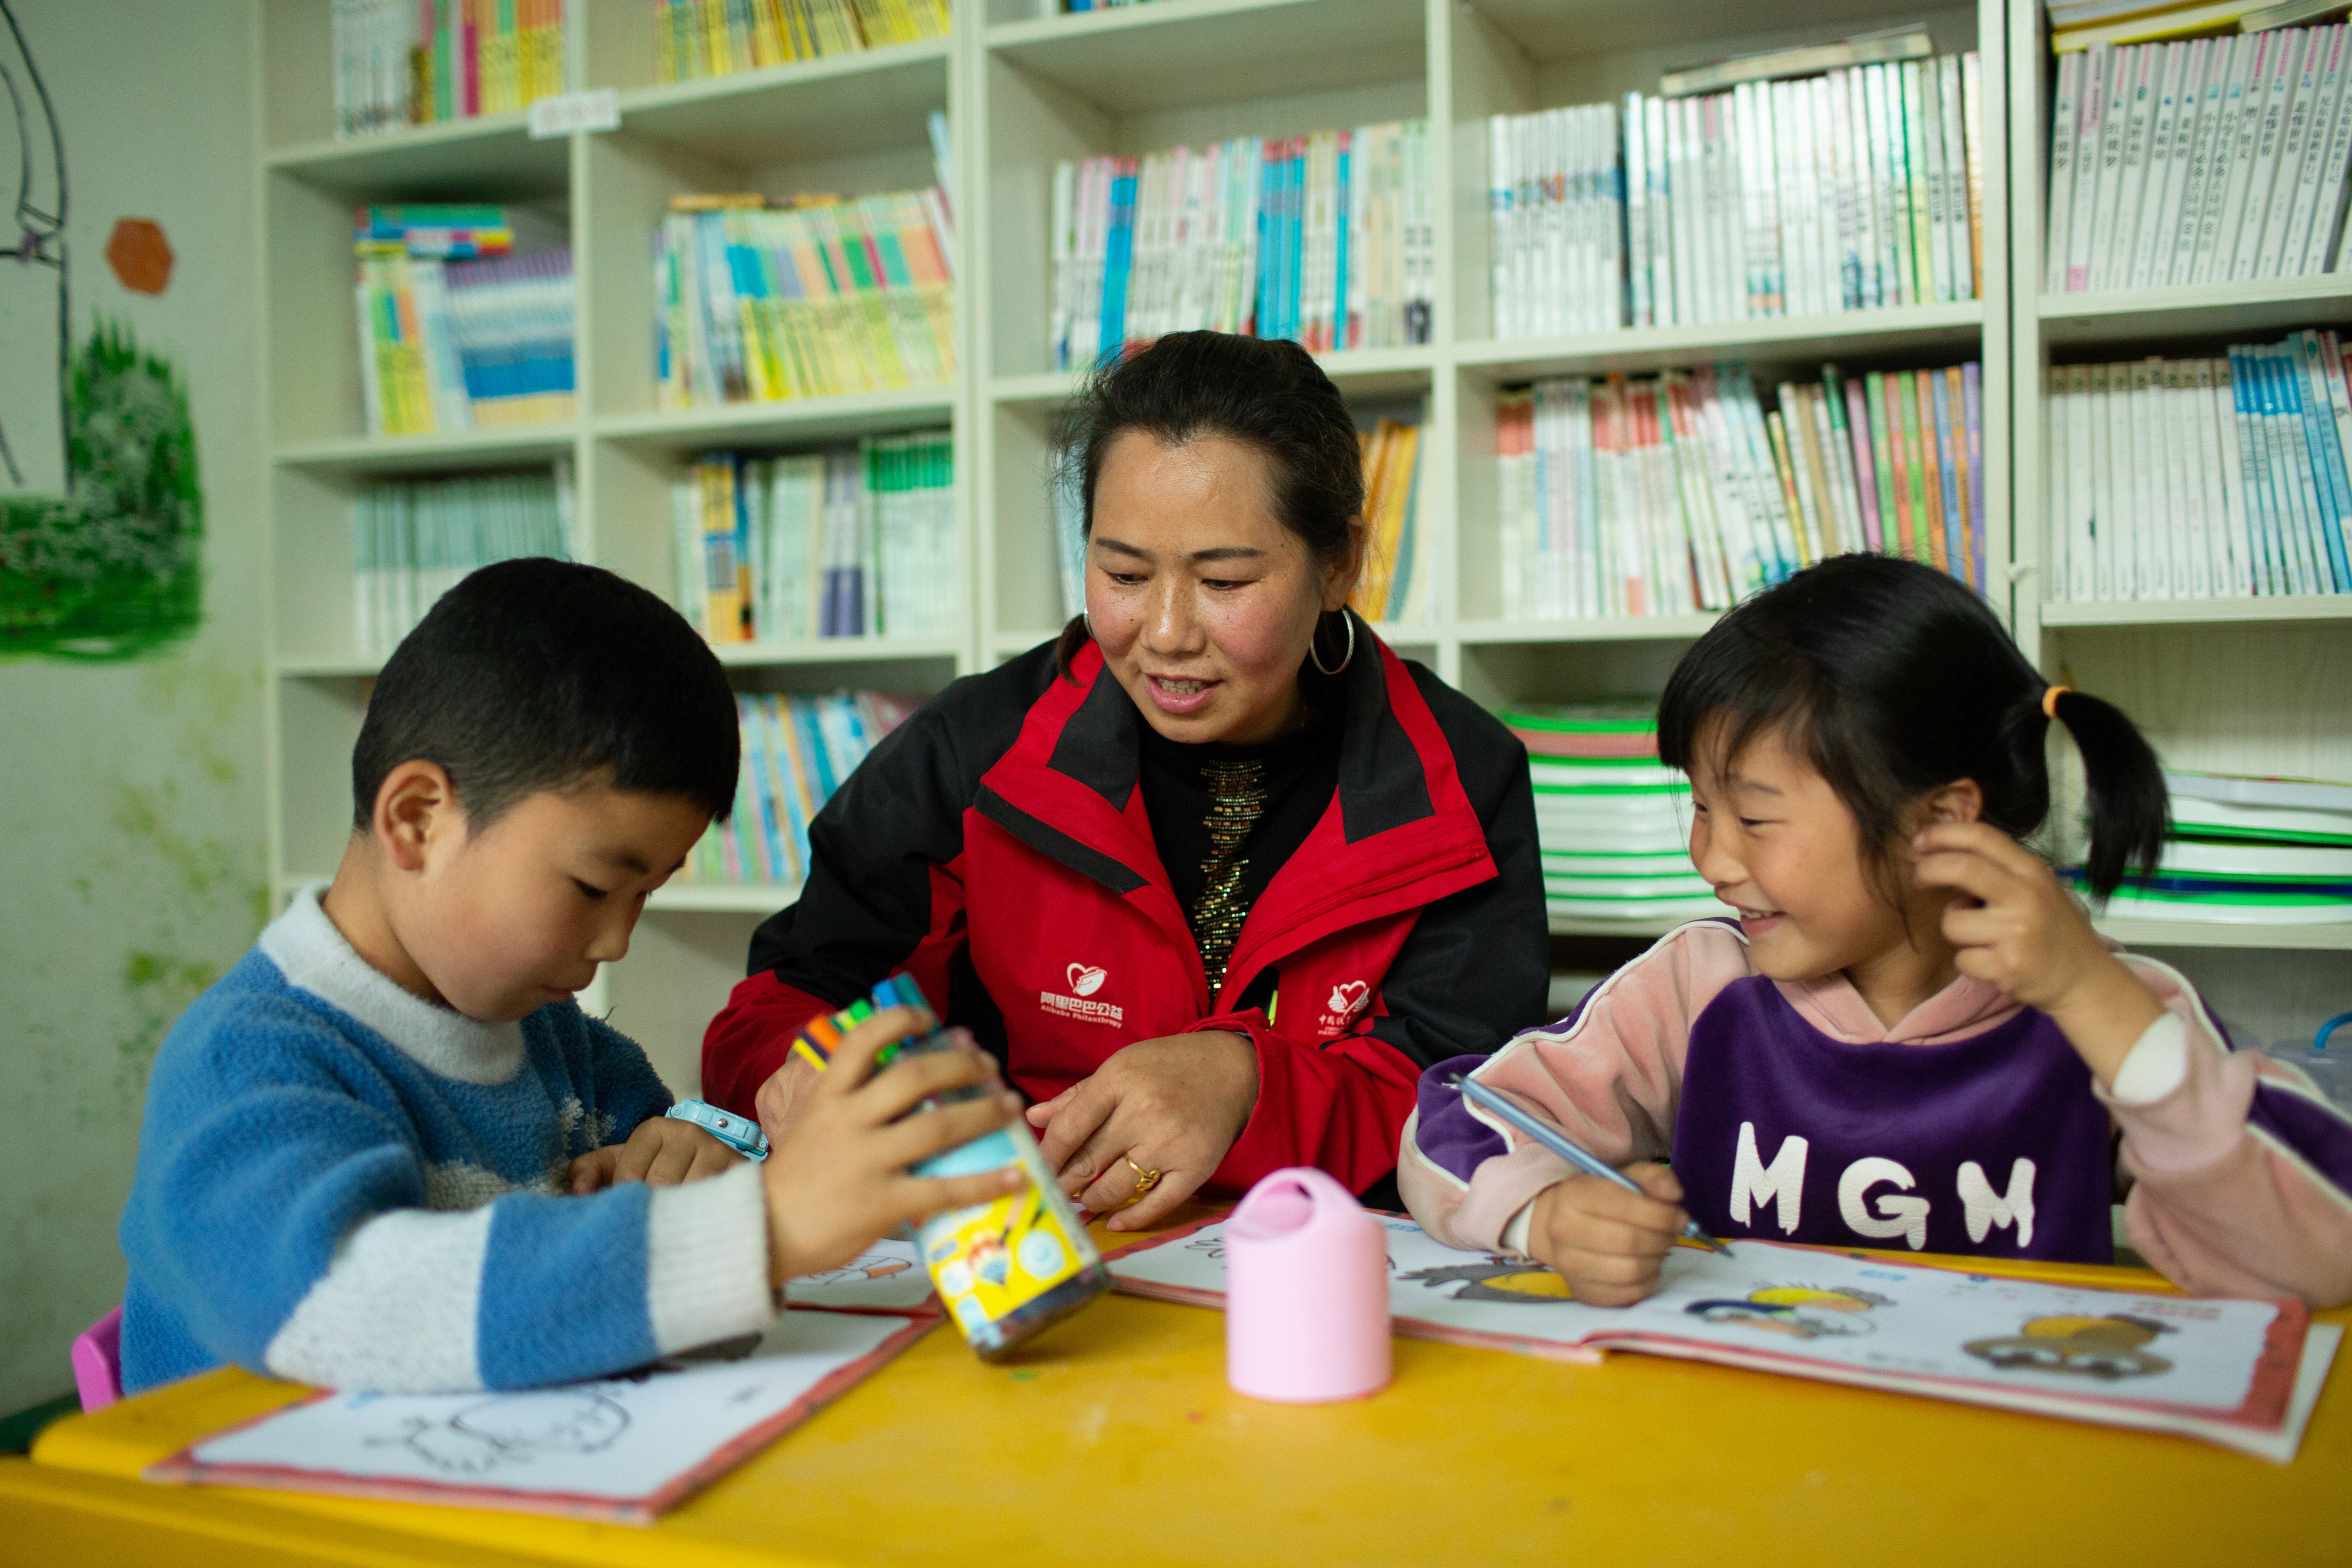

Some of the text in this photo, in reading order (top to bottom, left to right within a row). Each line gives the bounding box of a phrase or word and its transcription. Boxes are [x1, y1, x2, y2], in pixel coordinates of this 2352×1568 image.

[1040, 991, 1123, 1020] 阿里巴巴公益
[1040, 1004, 1122, 1029] Alibaba Philanthropy
